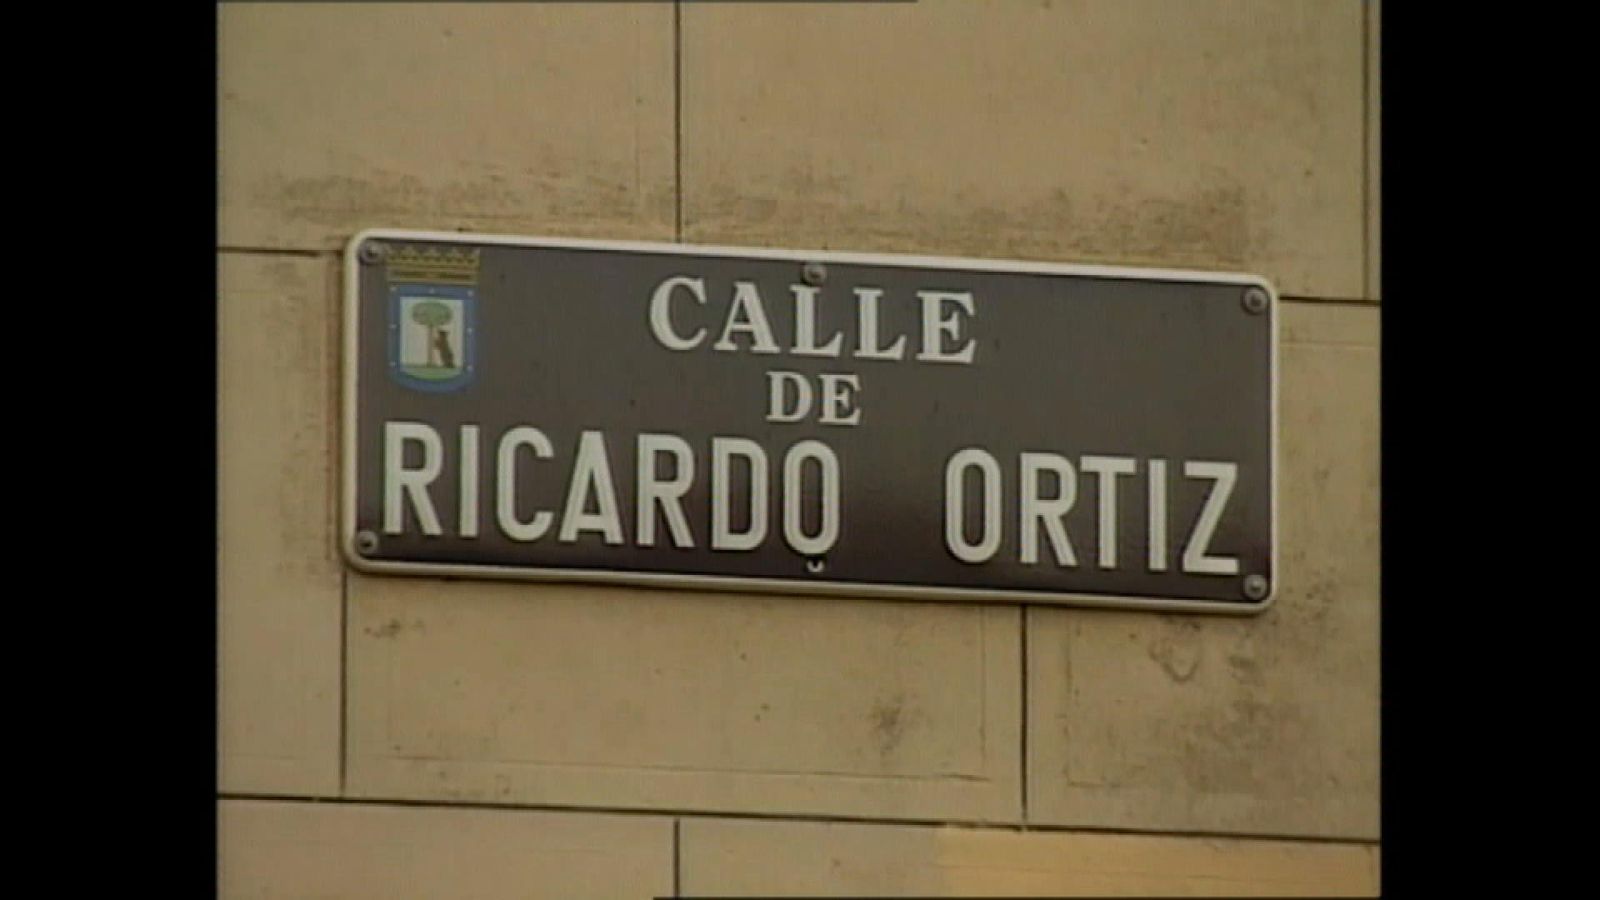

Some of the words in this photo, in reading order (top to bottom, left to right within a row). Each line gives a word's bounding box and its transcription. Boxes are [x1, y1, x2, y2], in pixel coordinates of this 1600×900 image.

[650, 276, 977, 364] CALLE
[766, 371, 862, 426] DE
[384, 421, 841, 556] RICARDO
[944, 448, 1240, 576] ORTIZ
